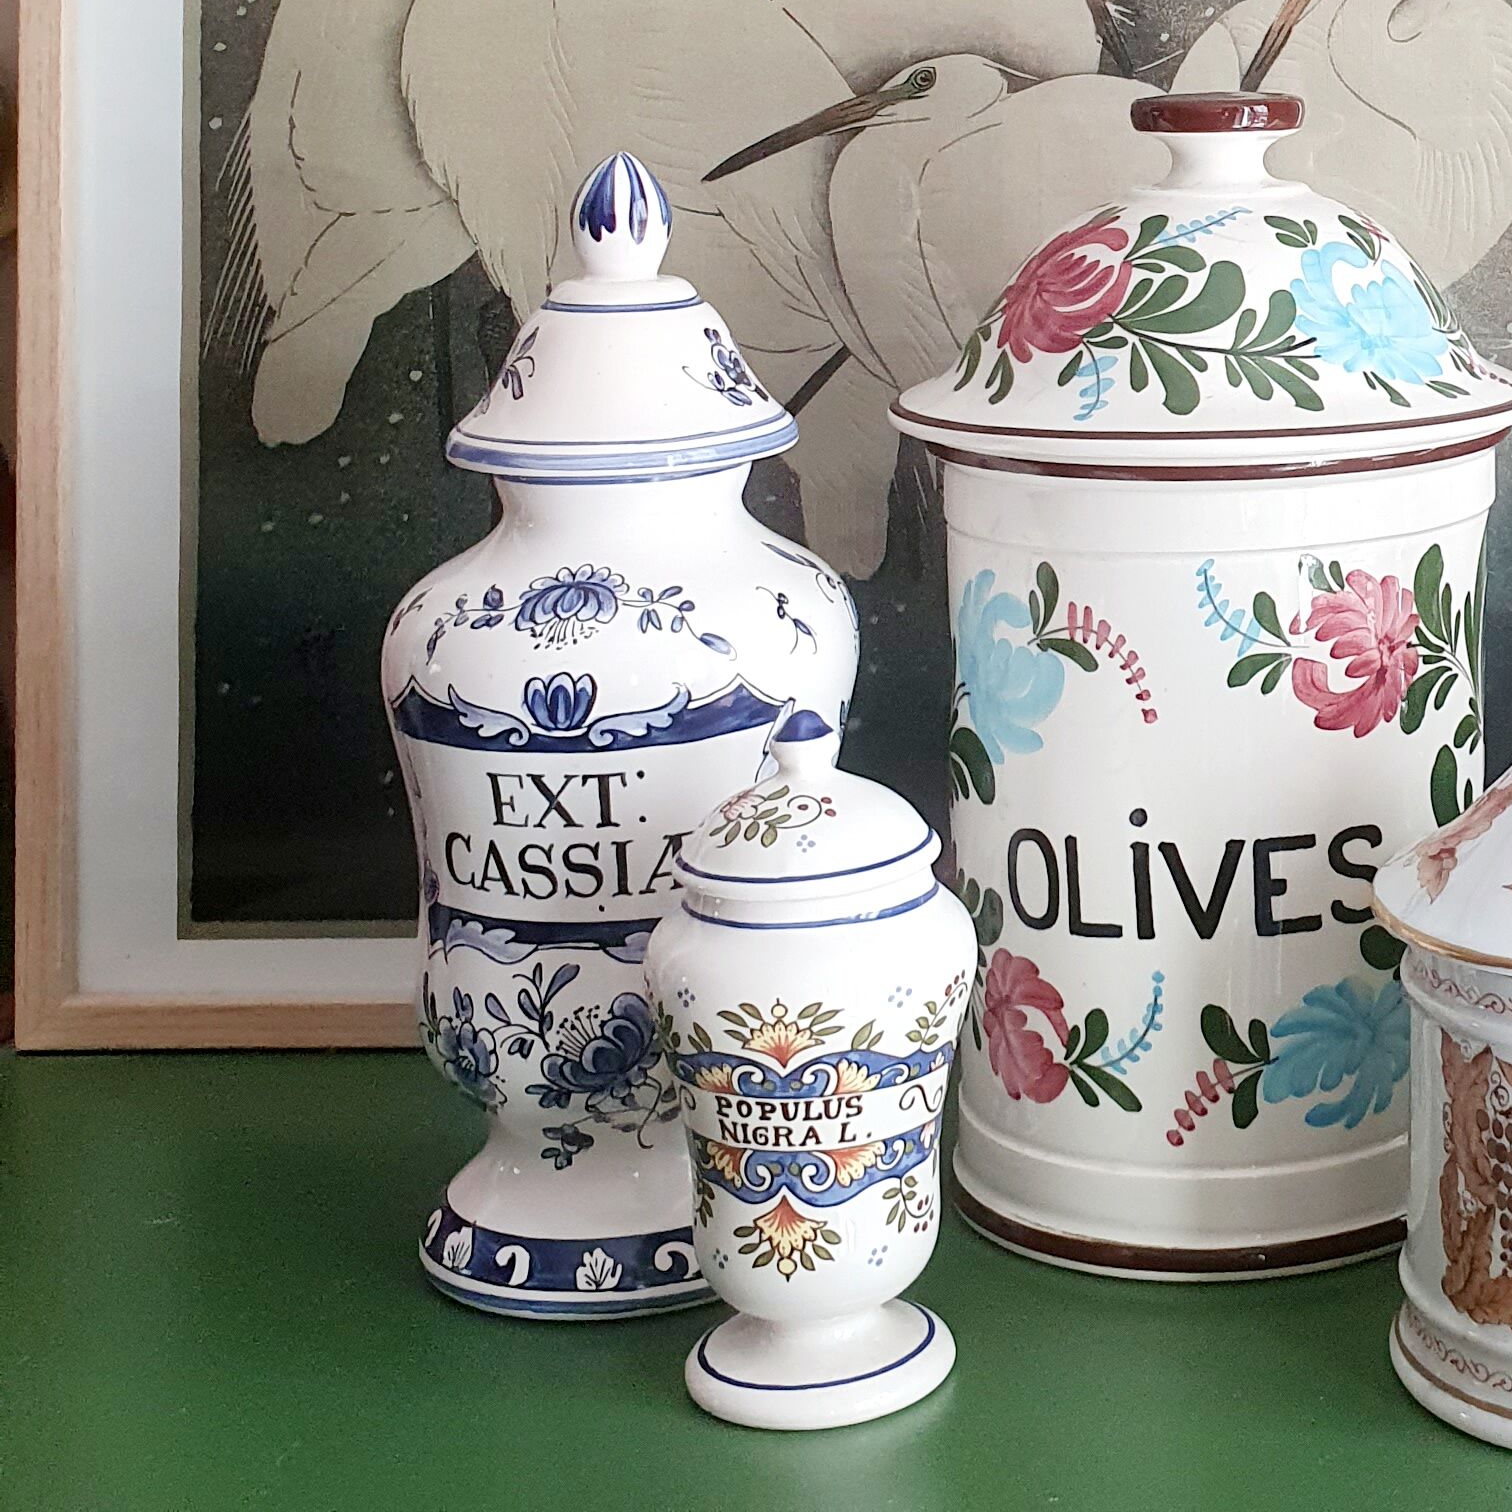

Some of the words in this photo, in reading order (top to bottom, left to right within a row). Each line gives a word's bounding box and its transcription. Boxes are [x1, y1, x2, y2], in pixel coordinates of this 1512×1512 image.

[485, 770, 647, 830] EXT:
[714, 1094, 864, 1122] POPULUS
[717, 1118, 823, 1148] NIGRA
